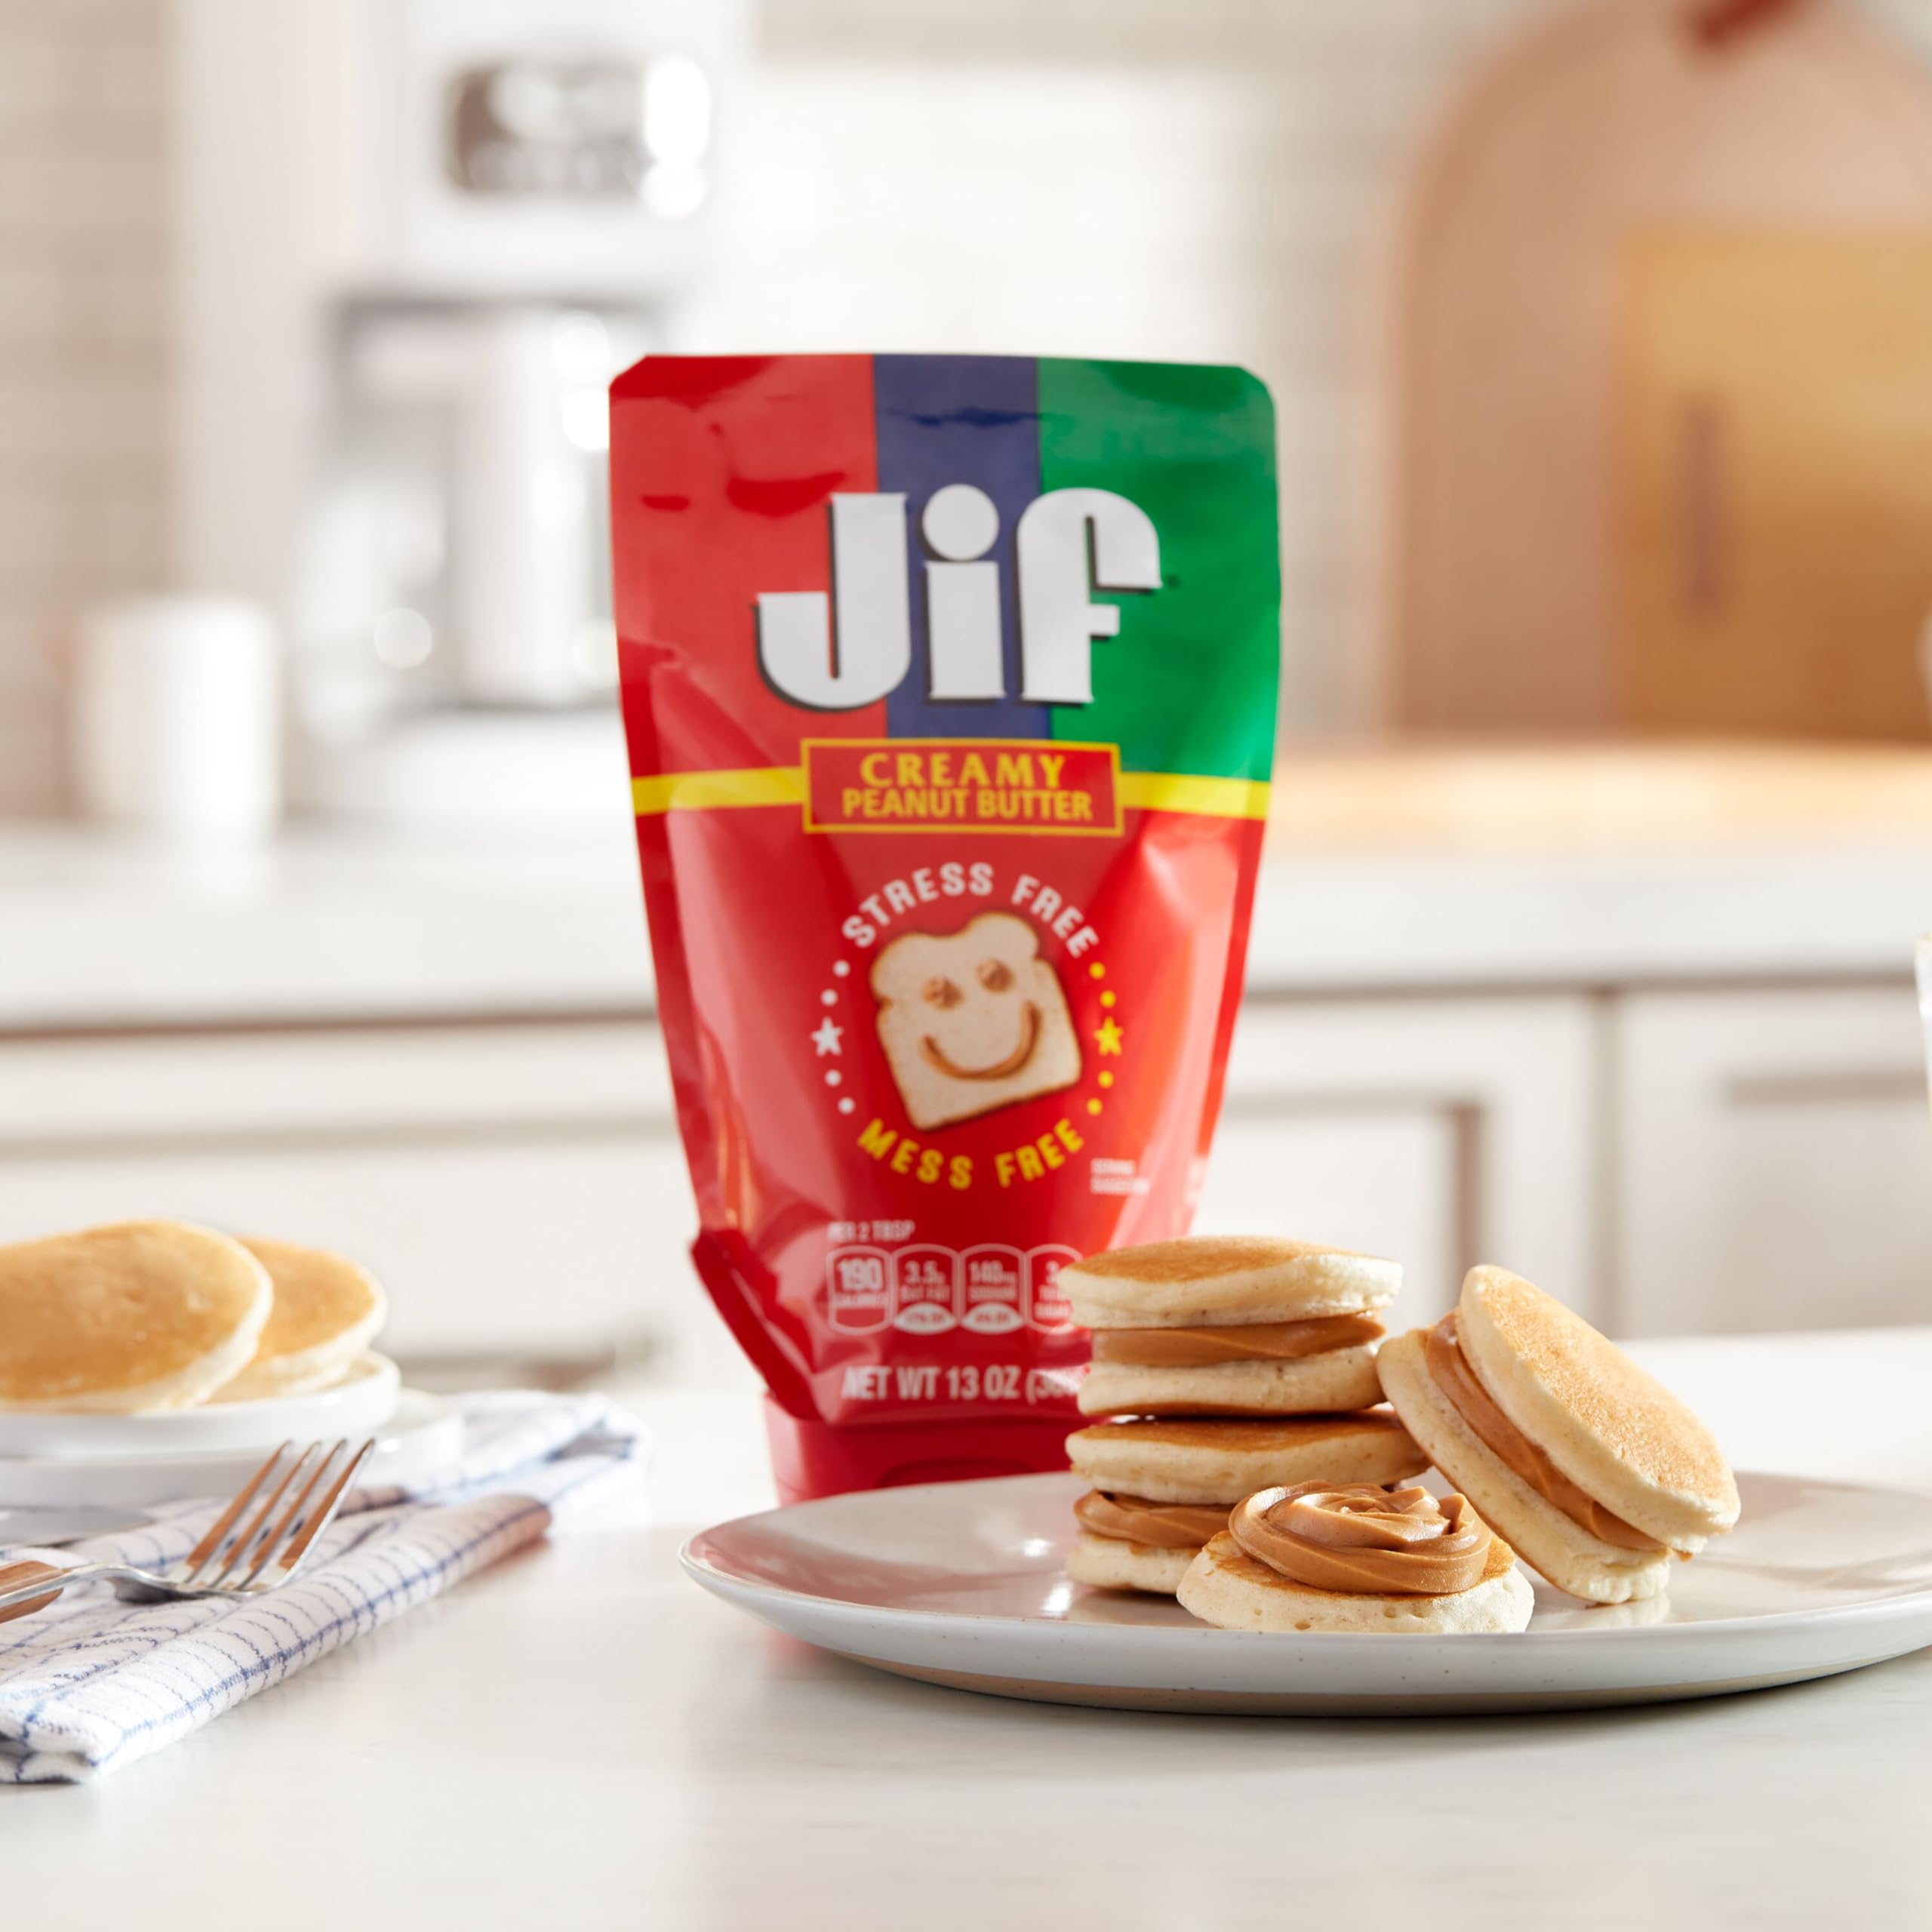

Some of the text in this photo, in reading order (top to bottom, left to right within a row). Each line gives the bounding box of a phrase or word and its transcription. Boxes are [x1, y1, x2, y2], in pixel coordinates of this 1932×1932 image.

[755, 484, 1163, 711] Jif
[860, 752, 1066, 789] CREAMY
[841, 787, 1093, 821] PEANUT BUTTER
[841, 862, 1099, 958] STRESS FREE
[857, 1118, 1084, 1190] MESS FREE
[838, 1257, 883, 1292] 190
[841, 1365, 892, 1401] NET
[896, 1365, 942, 1401] WT
[946, 1365, 980, 1401] 13
[983, 1364, 1022, 1400] OZ
